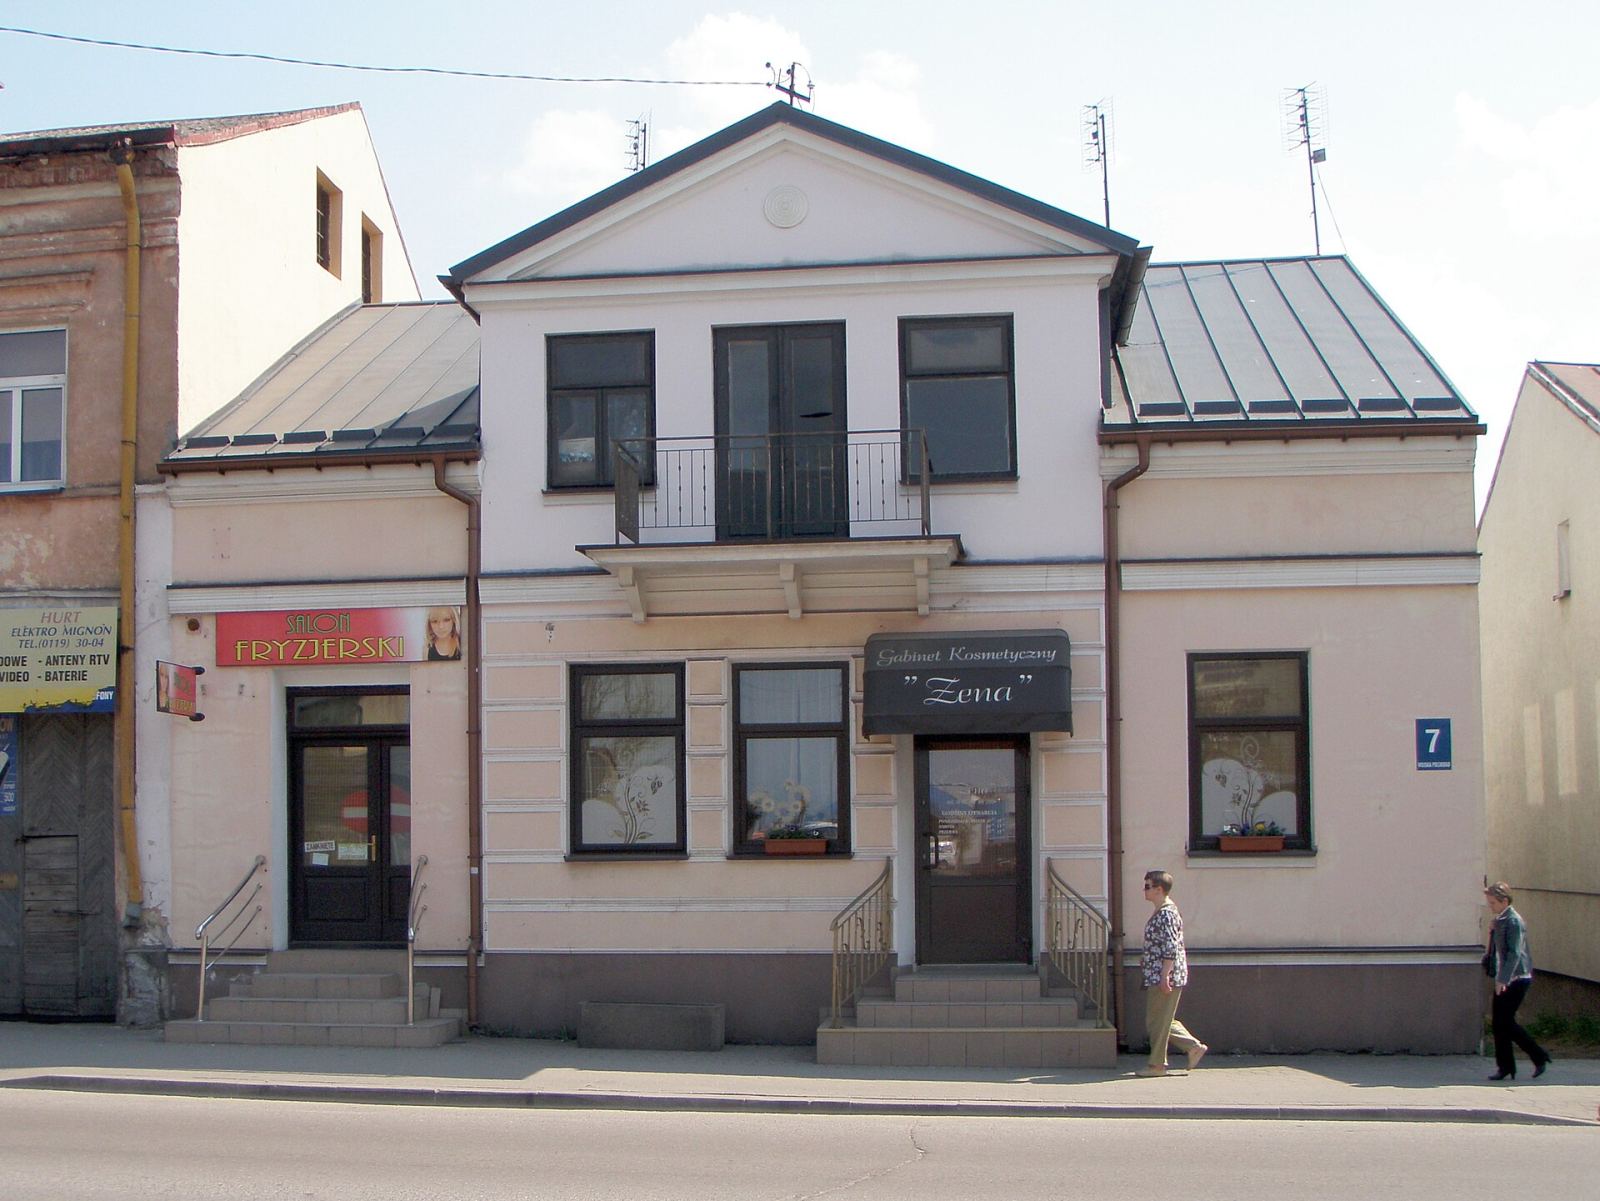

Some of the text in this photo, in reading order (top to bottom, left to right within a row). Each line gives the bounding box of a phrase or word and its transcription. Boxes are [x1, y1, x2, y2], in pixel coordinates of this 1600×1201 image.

[40, 611, 82, 624] HURT
[285, 613, 351, 635] SALON
[11, 625, 112, 637] ELEKTRO MIGNON
[75, 638, 104, 648] 30-04
[234, 636, 405, 661] FRYZJERSKI
[45, 654, 110, 666] ANTENY RTV
[876, 645, 1057, 667] Gabinet Kosmetyczny
[44, 670, 88, 681] BATERIE
[1424, 728, 1440, 753] 7
